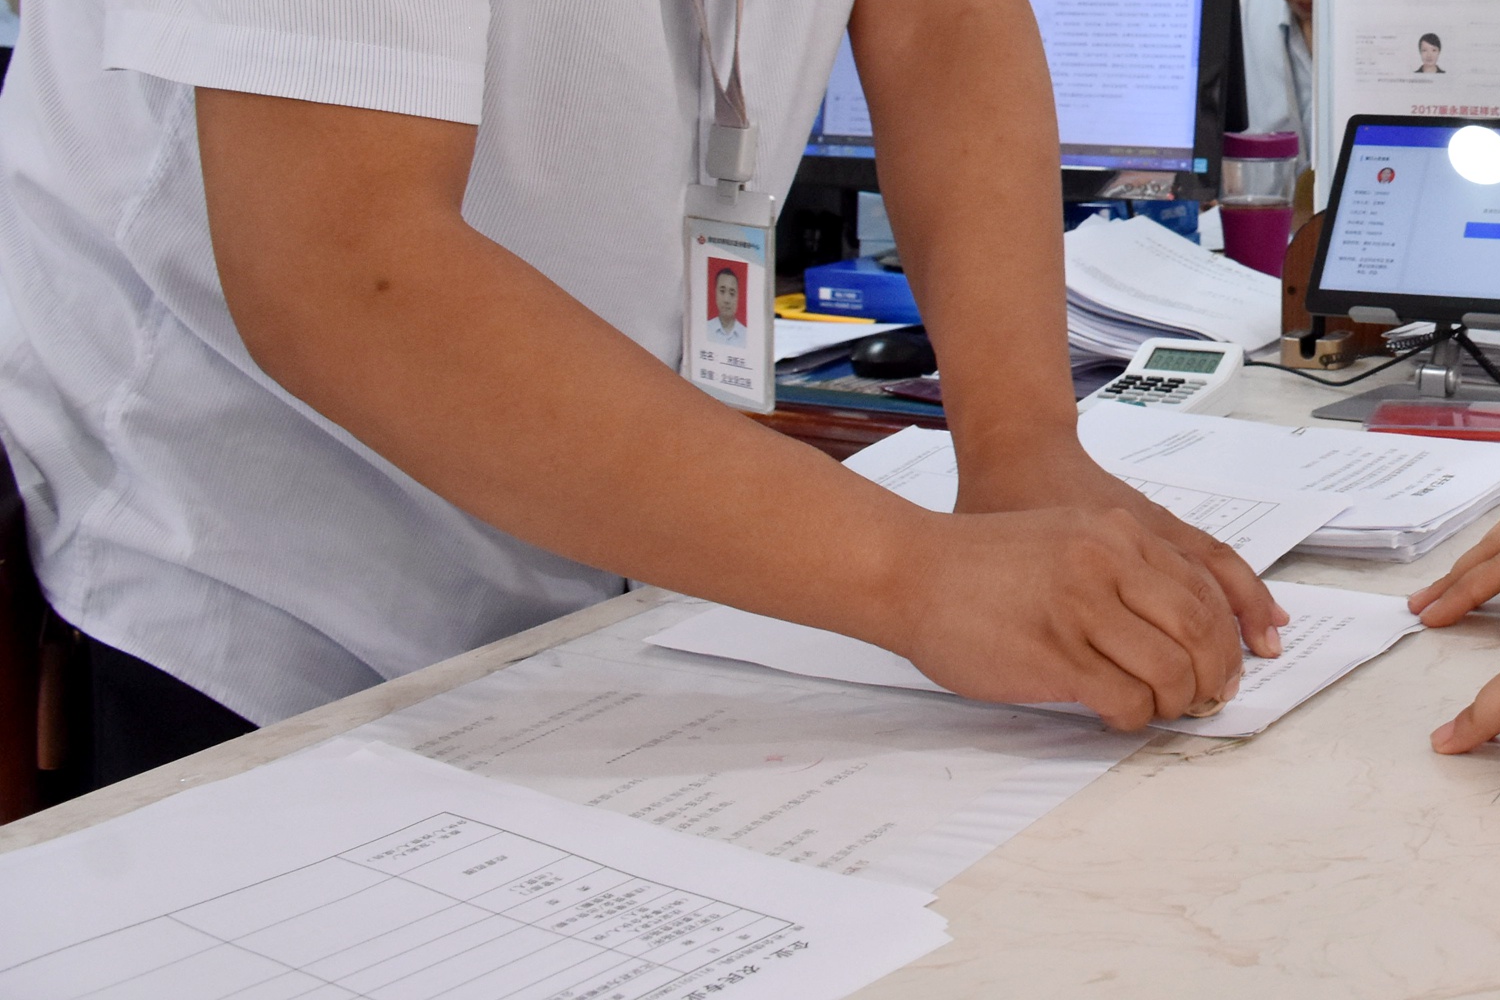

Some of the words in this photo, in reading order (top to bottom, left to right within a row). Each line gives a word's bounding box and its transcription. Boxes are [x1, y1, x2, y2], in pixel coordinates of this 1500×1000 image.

[1410, 104, 1500, 116] 2017版永居证样式
